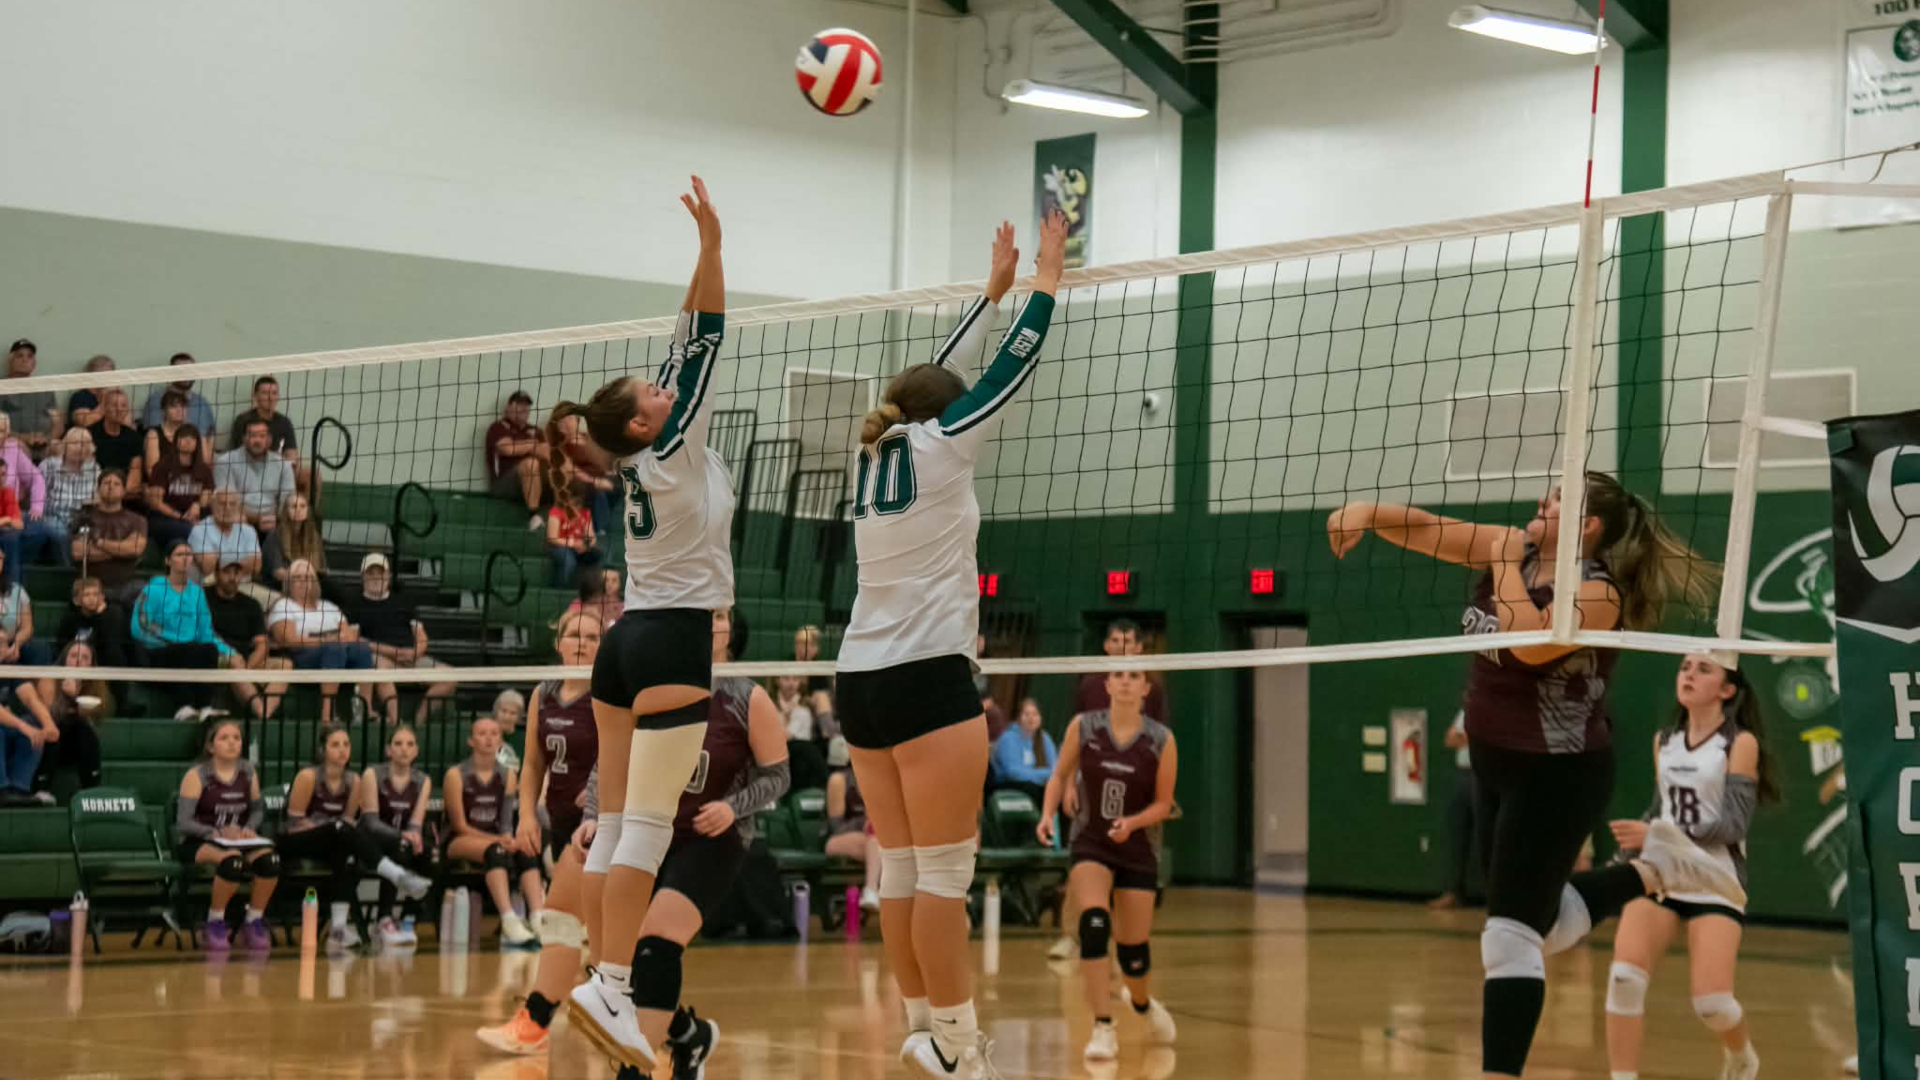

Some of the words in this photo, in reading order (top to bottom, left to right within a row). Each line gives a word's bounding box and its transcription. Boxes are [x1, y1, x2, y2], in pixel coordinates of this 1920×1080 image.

[546, 735, 569, 773] 2
[81, 797, 136, 813] HORNETS
[1668, 786, 1701, 826] 18
